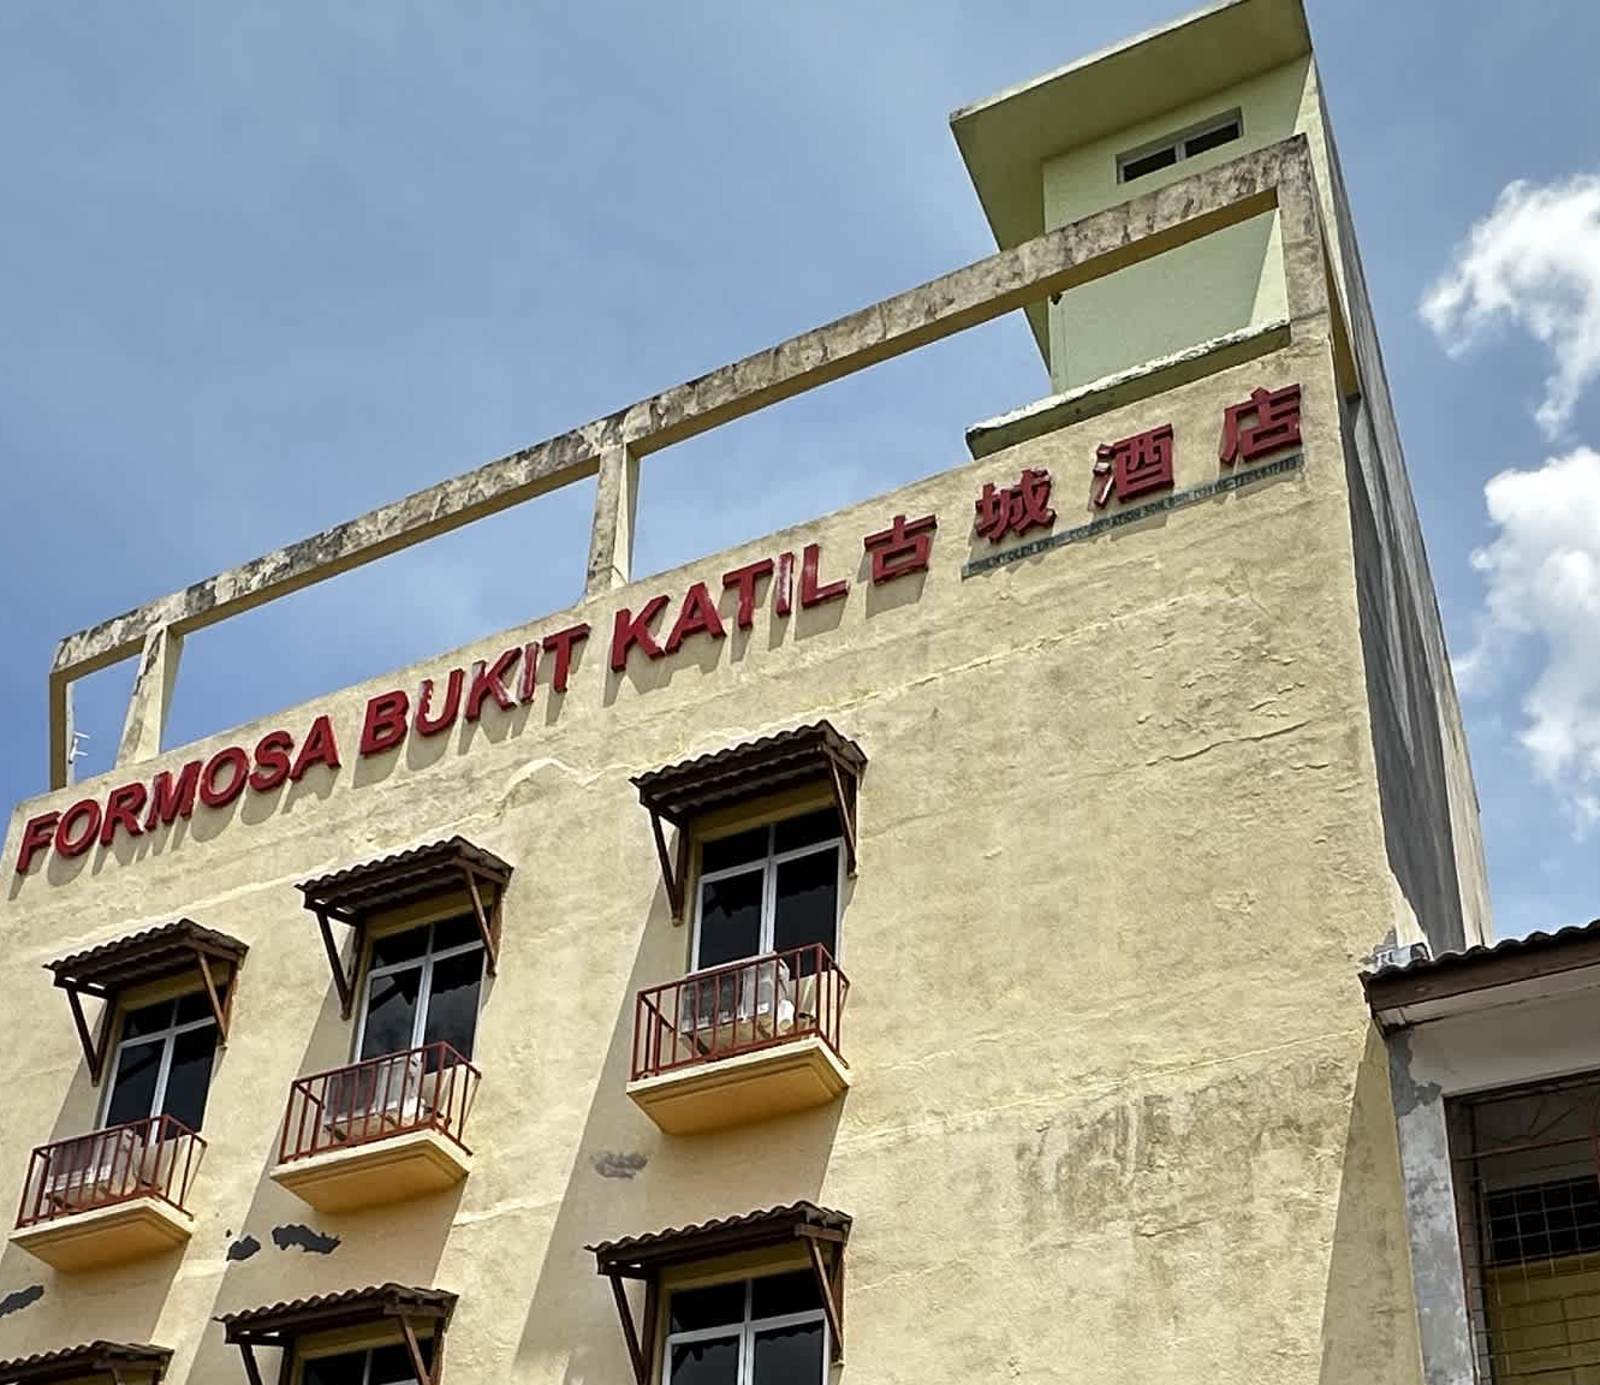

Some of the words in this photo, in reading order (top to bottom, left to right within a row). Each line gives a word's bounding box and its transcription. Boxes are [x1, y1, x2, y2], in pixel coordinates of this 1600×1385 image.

[864, 383, 1302, 586] 古城酒店
[15, 715, 342, 875] FORMOSA
[360, 622, 591, 759] BUKIT
[611, 543, 848, 673] KATIL
